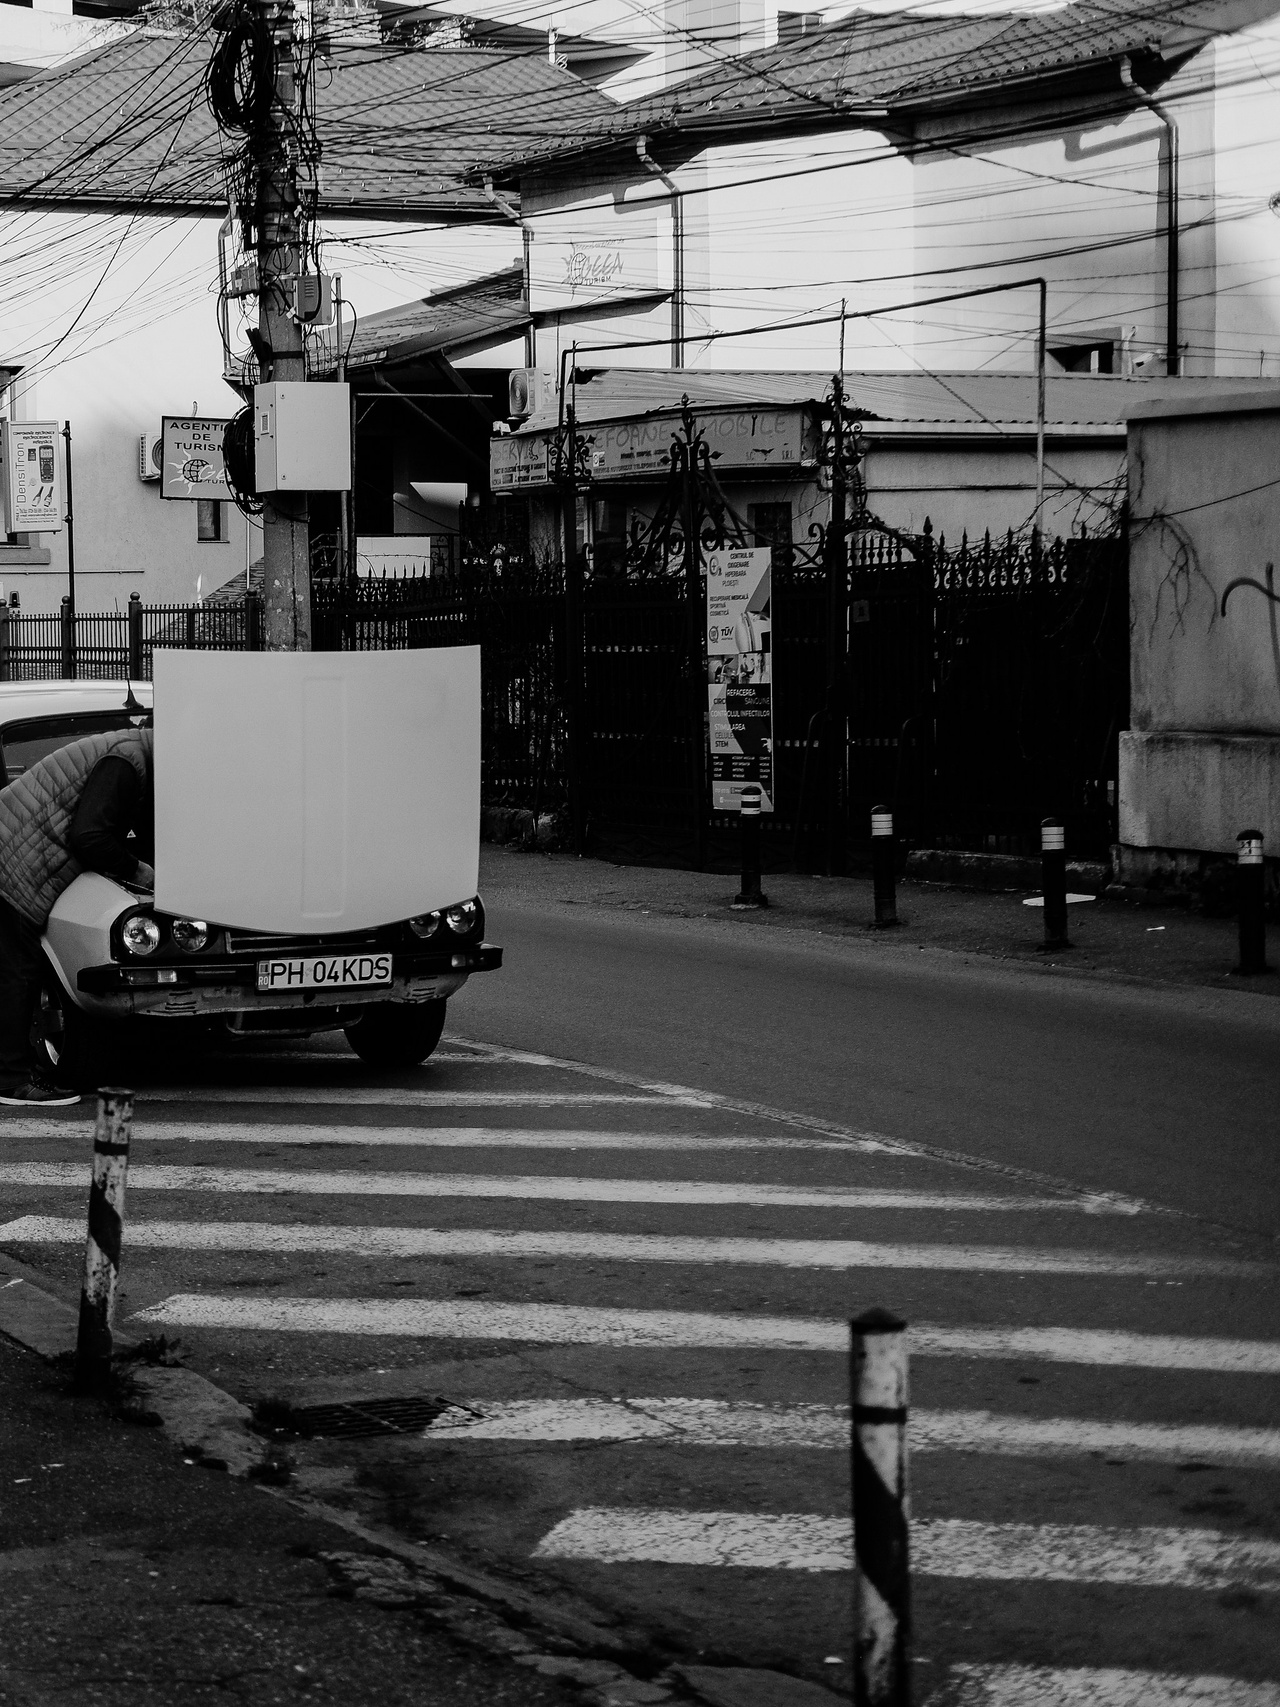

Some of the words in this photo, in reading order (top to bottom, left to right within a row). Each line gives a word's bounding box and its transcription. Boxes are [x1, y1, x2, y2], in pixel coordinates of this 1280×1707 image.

[170, 422, 223, 431] AGENTI
[270, 962, 304, 985] PH
[259, 976, 268, 985] RO
